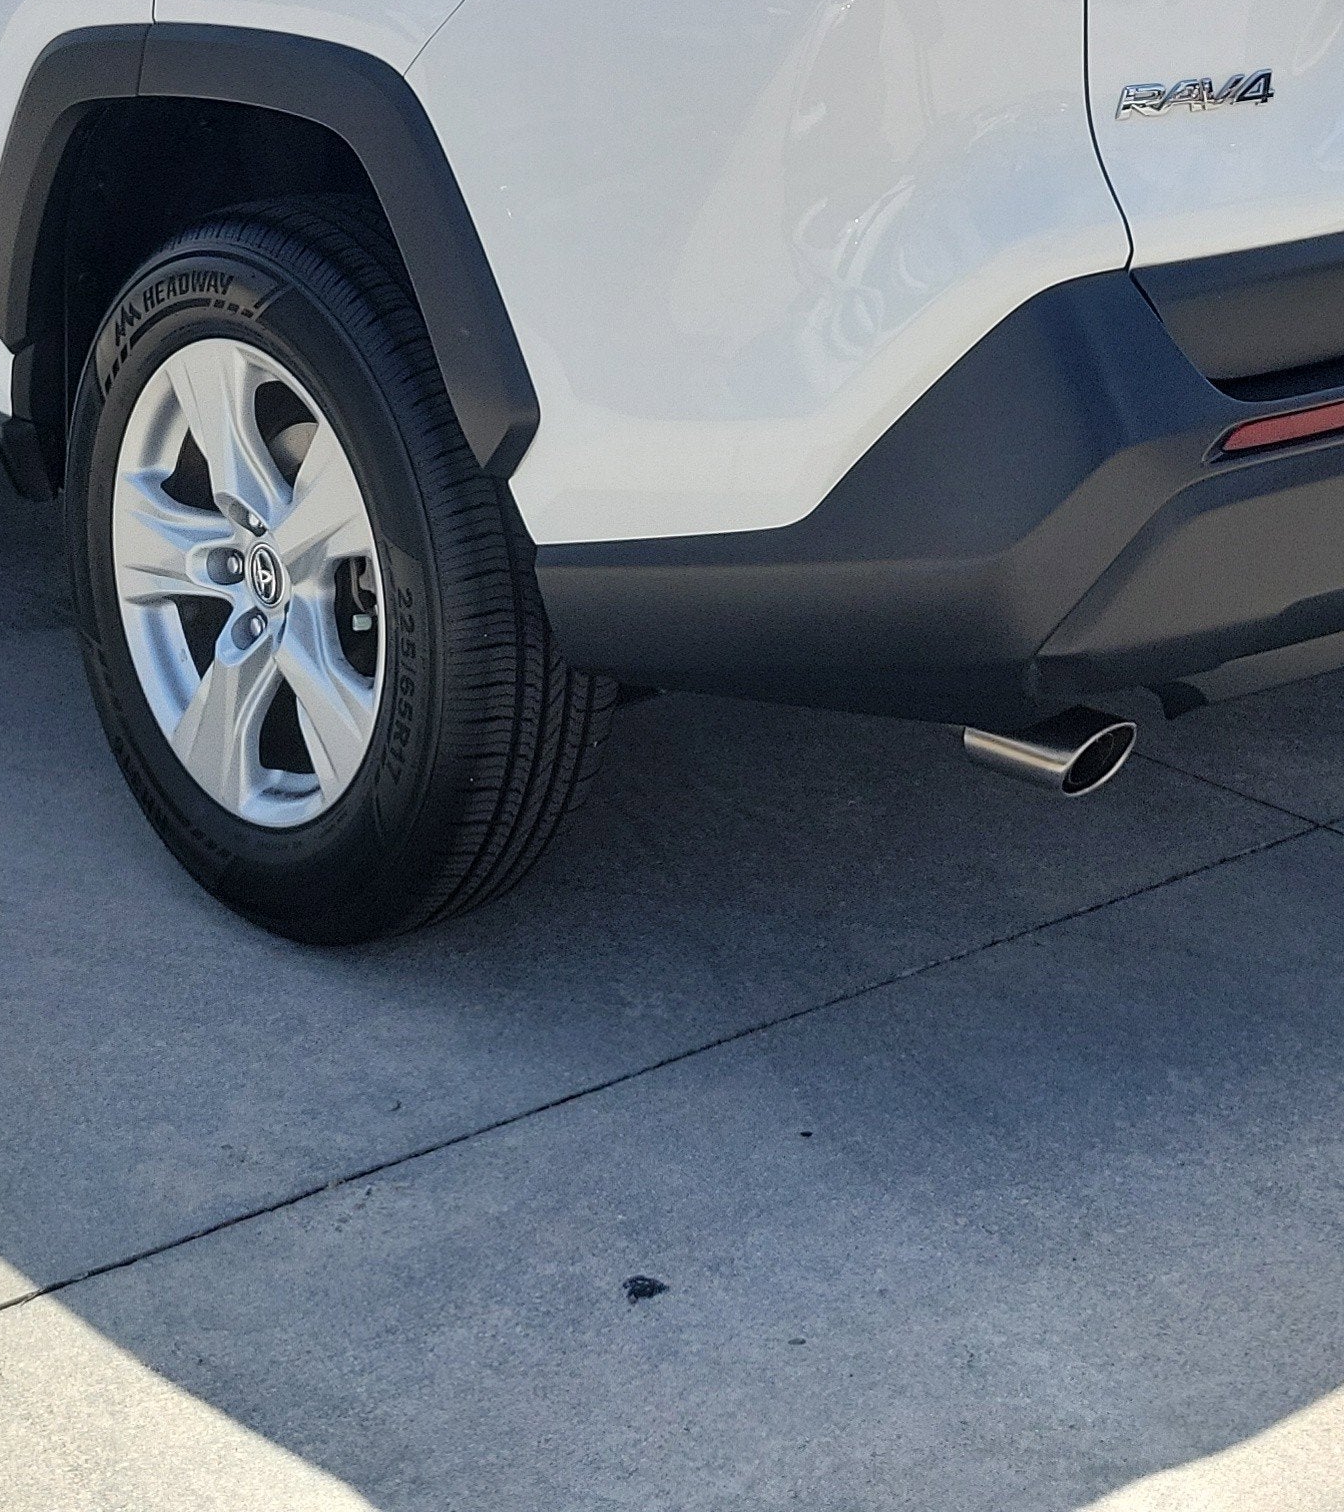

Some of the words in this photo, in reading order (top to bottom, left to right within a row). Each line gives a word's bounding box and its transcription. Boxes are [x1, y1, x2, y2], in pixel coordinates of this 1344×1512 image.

[1115, 68, 1275, 121] RAV4
[142, 270, 235, 313] HEADWAY
[387, 587, 417, 786] 225/65R17
